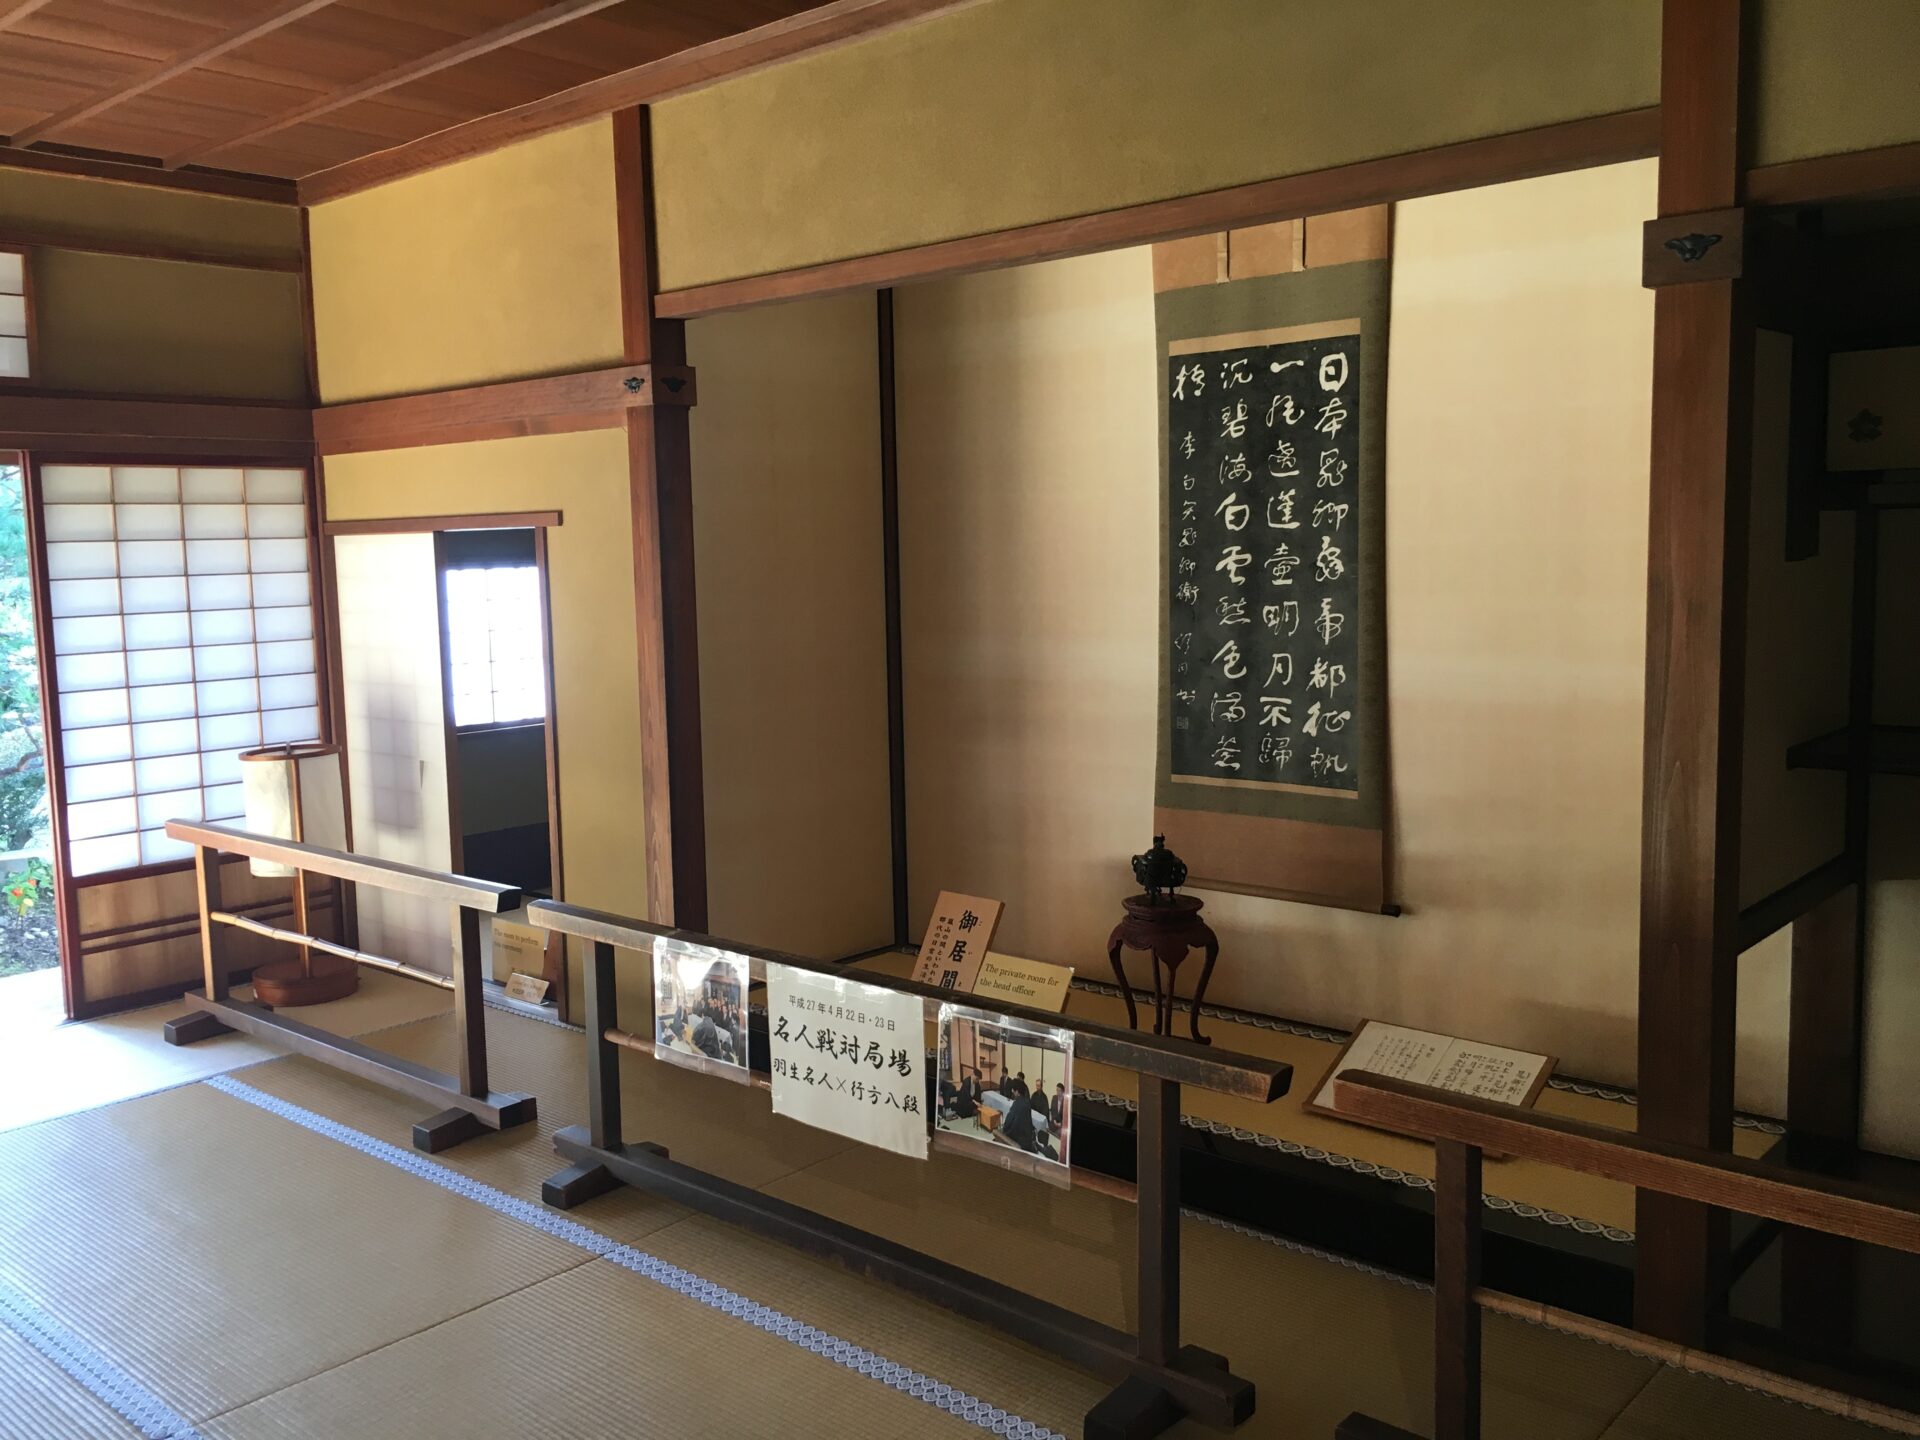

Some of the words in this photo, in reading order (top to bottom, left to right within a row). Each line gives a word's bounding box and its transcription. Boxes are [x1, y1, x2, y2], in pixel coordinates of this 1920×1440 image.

[940, 909, 979, 990] 御居間
[979, 977, 992, 987] the
[992, 979, 1011, 991] head
[1011, 984, 1036, 997] officer
[985, 963, 999, 975] The
[999, 967, 1026, 980] private
[1027, 974, 1046, 984] room
[1047, 976, 1060, 987] for
[788, 994, 896, 1032] 平成27年4月22日・23日
[773, 1015, 912, 1077] 名人戦対局場
[773, 1058, 921, 1115] 羽生名人×行方八段
